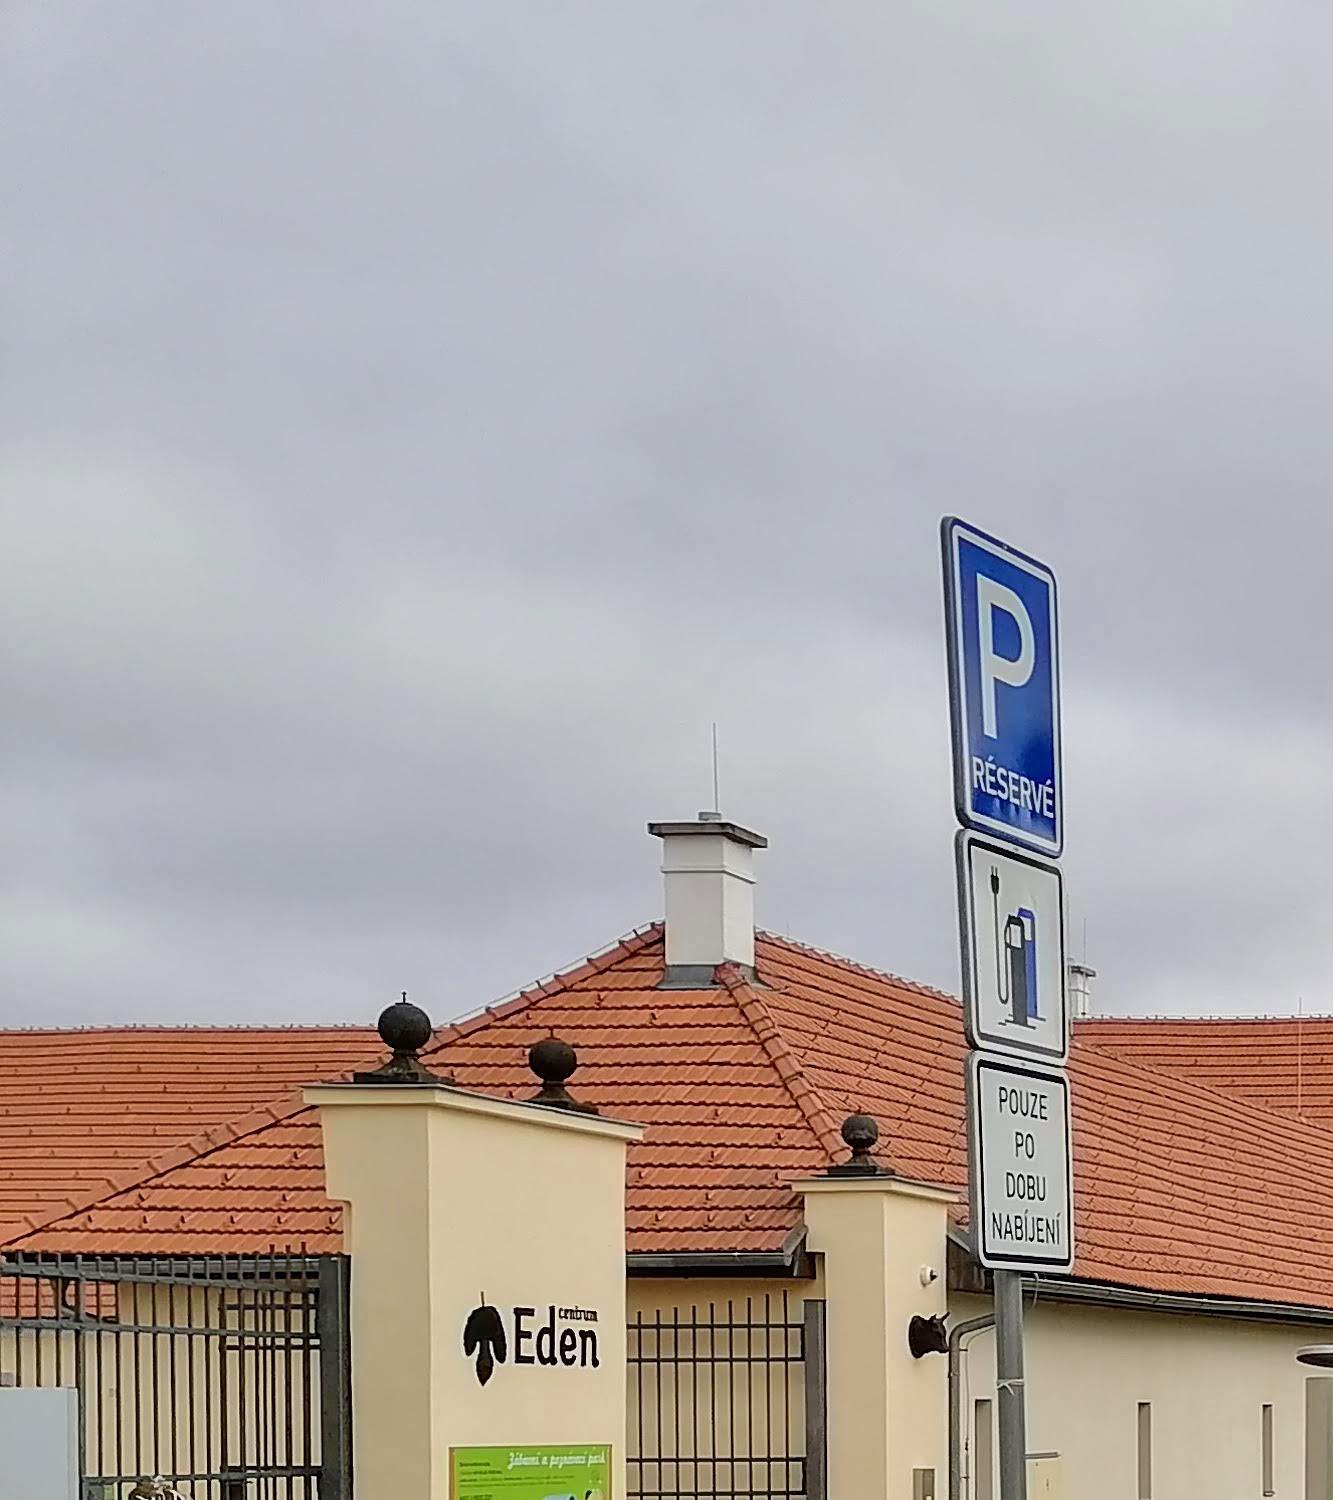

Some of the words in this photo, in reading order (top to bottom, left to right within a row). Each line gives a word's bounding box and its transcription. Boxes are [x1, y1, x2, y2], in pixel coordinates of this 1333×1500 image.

[976, 572, 1036, 740] P
[972, 756, 1055, 819] RÉSERVÉ
[999, 1086, 1048, 1121] POUZE
[1015, 1131, 1035, 1159] PO
[1006, 1172, 1046, 1201] DOBU
[992, 1209, 1061, 1245] NABÍJENÍ
[558, 1306, 598, 1322] centrum
[513, 1305, 600, 1368] Eden
